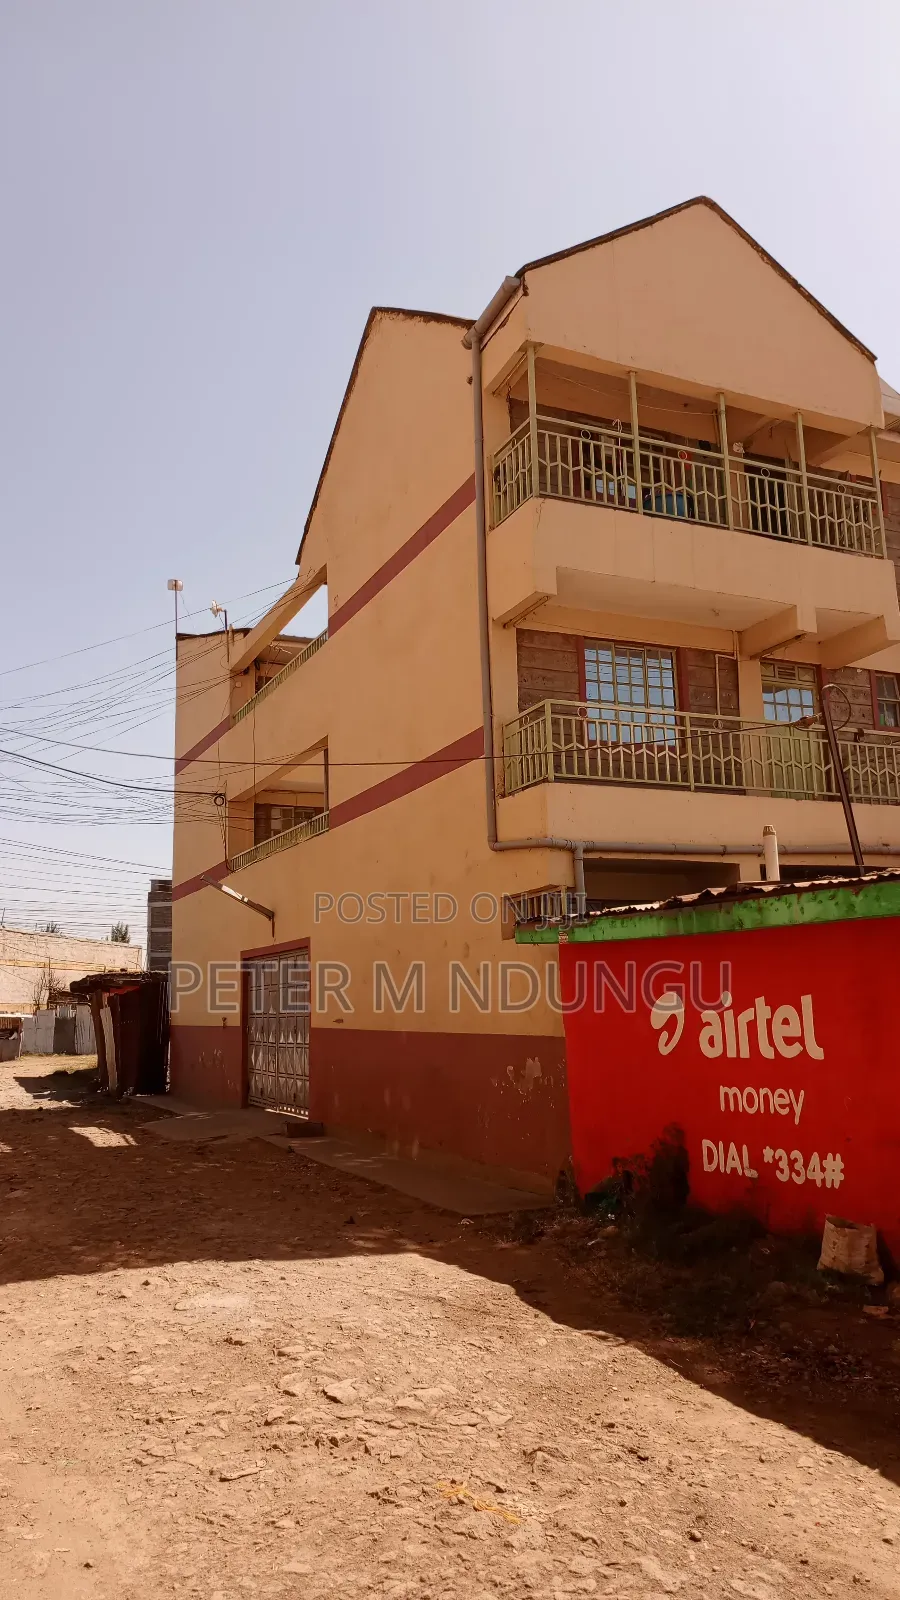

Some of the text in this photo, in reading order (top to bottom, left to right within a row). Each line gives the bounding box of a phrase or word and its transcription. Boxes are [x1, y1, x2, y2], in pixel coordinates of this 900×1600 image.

[699, 991, 824, 1060] airtel
[719, 1085, 804, 1125] money
[702, 1139, 758, 1178] DIAL
